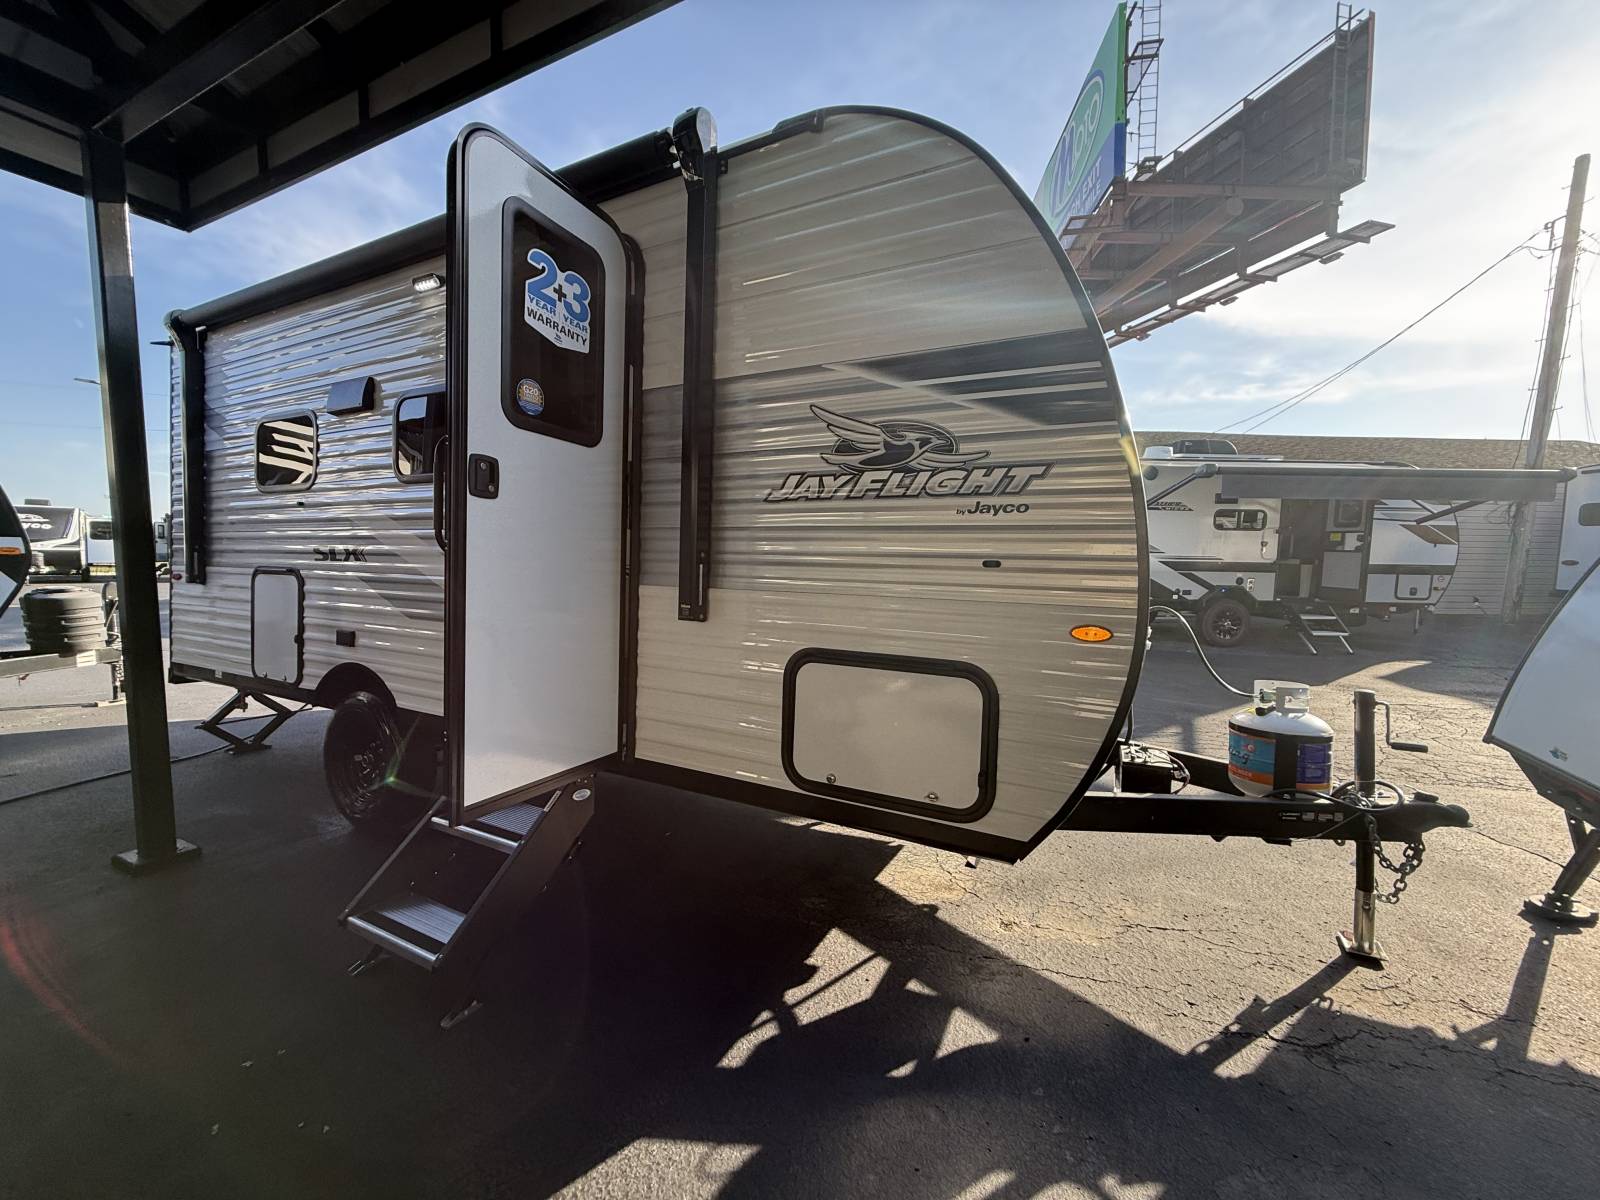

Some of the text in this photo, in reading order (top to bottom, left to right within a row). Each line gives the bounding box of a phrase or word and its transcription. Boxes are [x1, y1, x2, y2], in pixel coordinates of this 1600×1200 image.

[528, 294, 588, 334] YEAR YEAR
[527, 306, 588, 346] WARRANTY
[967, 501, 1030, 516] Jayco
[21, 522, 53, 530] yco
[313, 547, 367, 562] SLX
